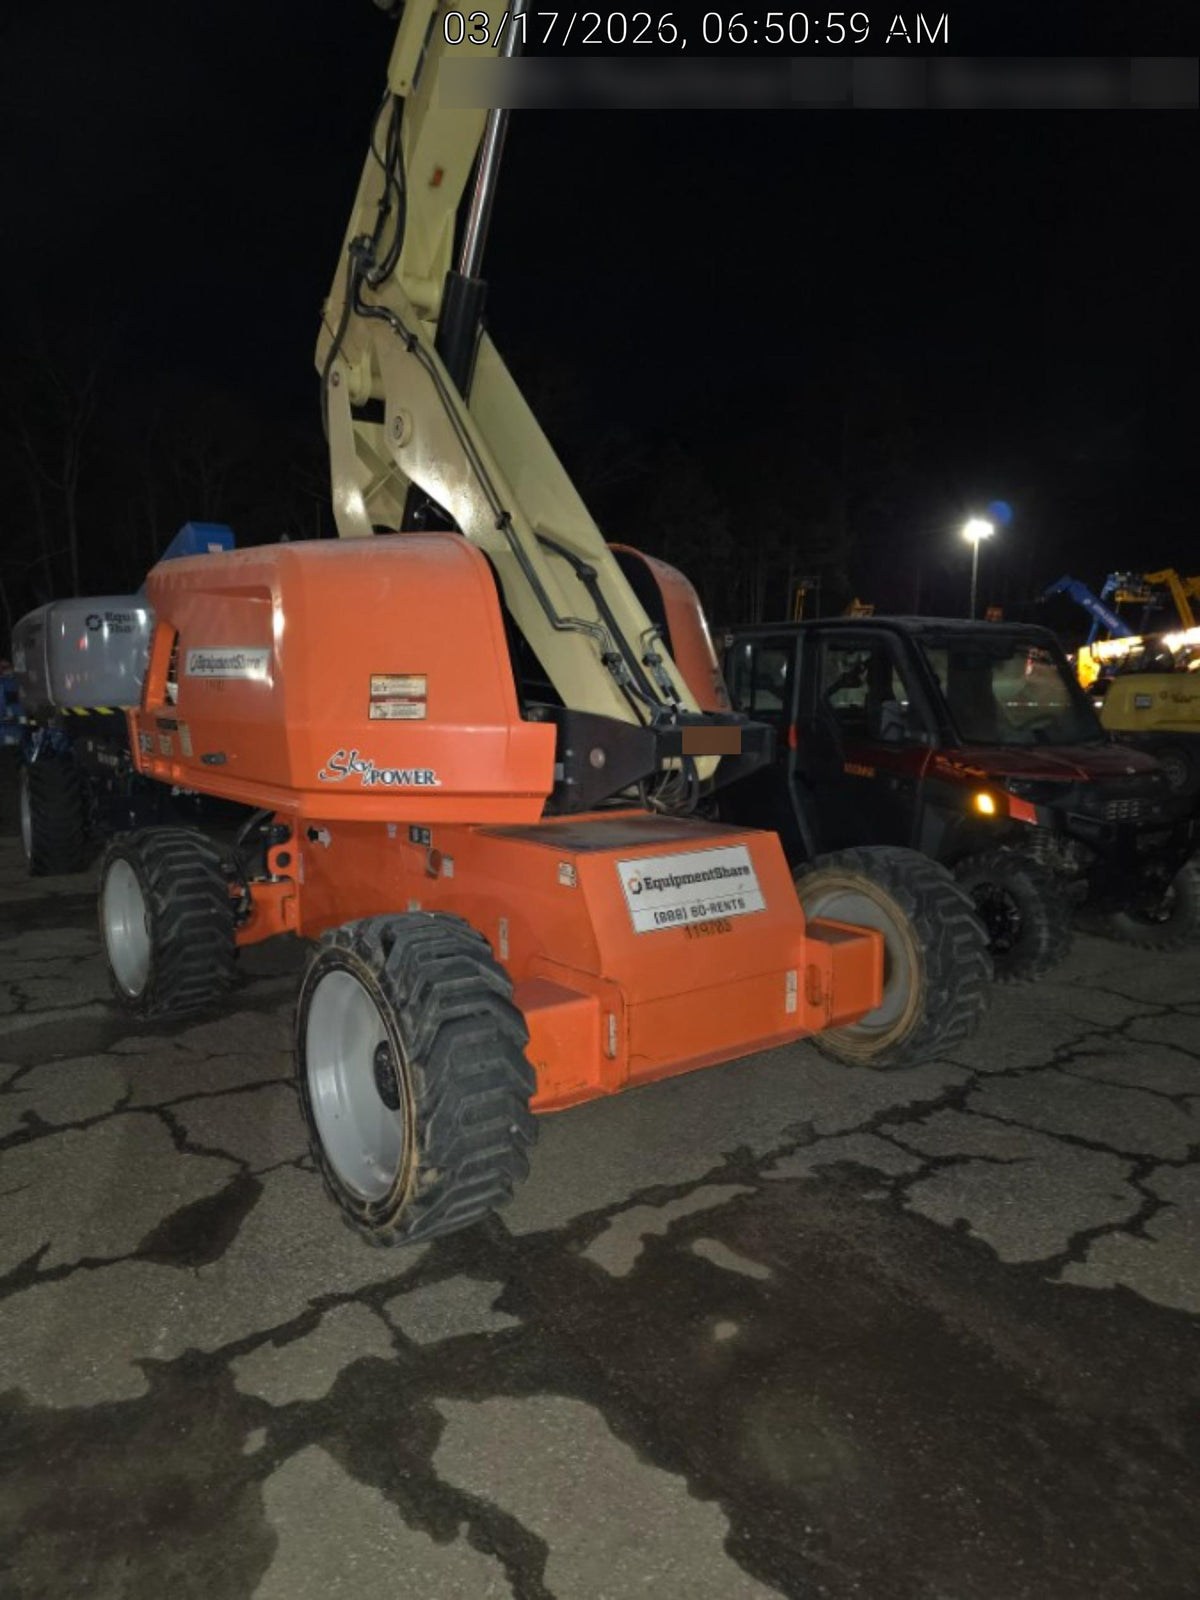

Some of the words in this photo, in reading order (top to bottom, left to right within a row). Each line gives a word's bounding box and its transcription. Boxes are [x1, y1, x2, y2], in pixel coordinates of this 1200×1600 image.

[318, 749, 374, 786] Sky
[370, 769, 436, 786] POWER
[643, 864, 750, 892] EquipmentShare
